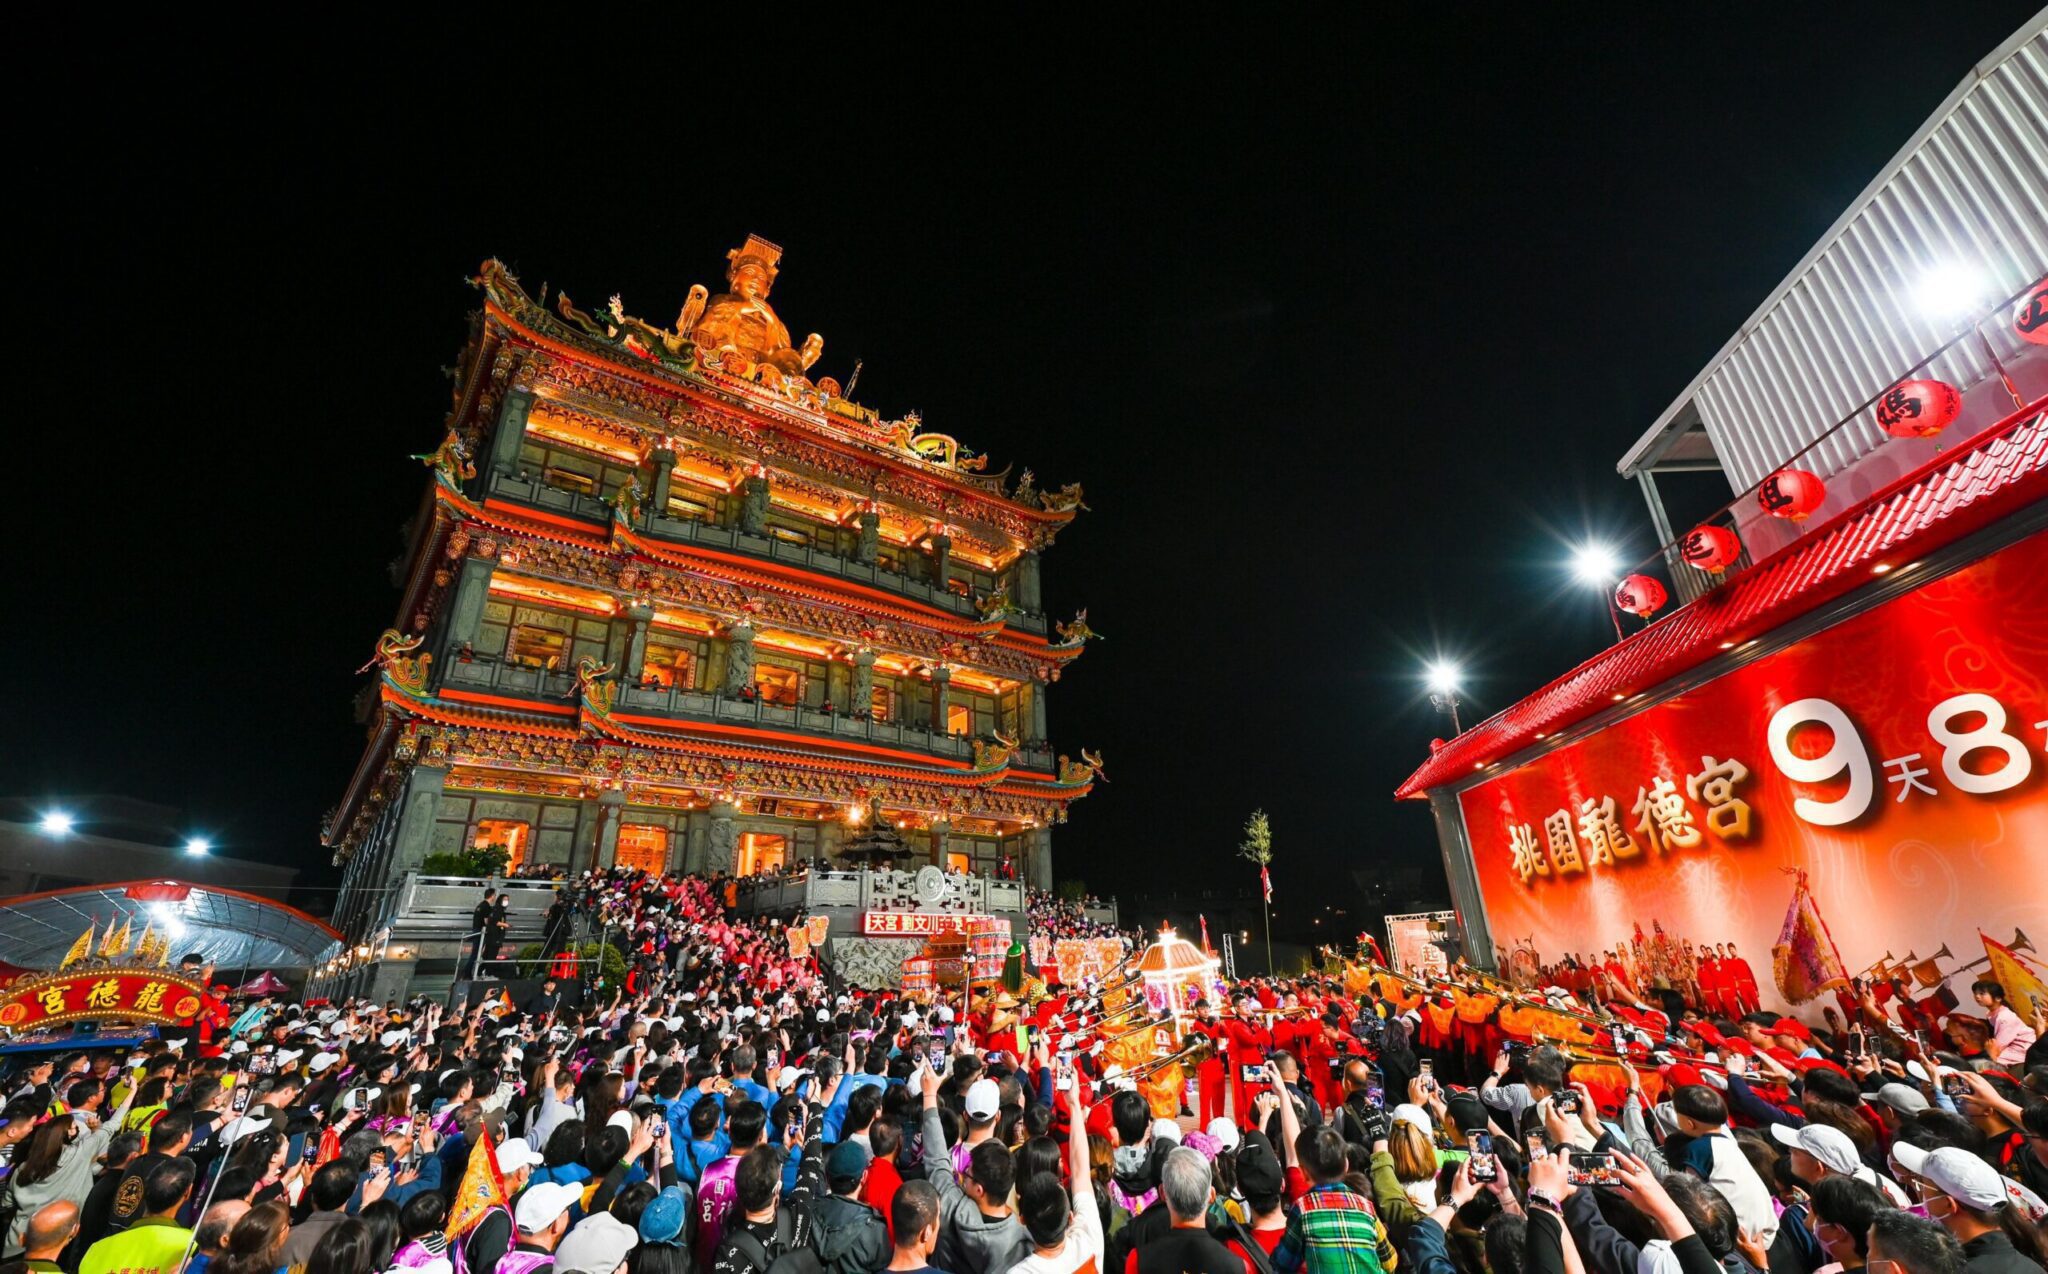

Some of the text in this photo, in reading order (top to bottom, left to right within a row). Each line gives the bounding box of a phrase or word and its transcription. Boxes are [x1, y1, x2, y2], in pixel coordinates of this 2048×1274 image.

[1509, 755, 1748, 883] 桃園龍德宮
[1767, 692, 2048, 826] 9天8
